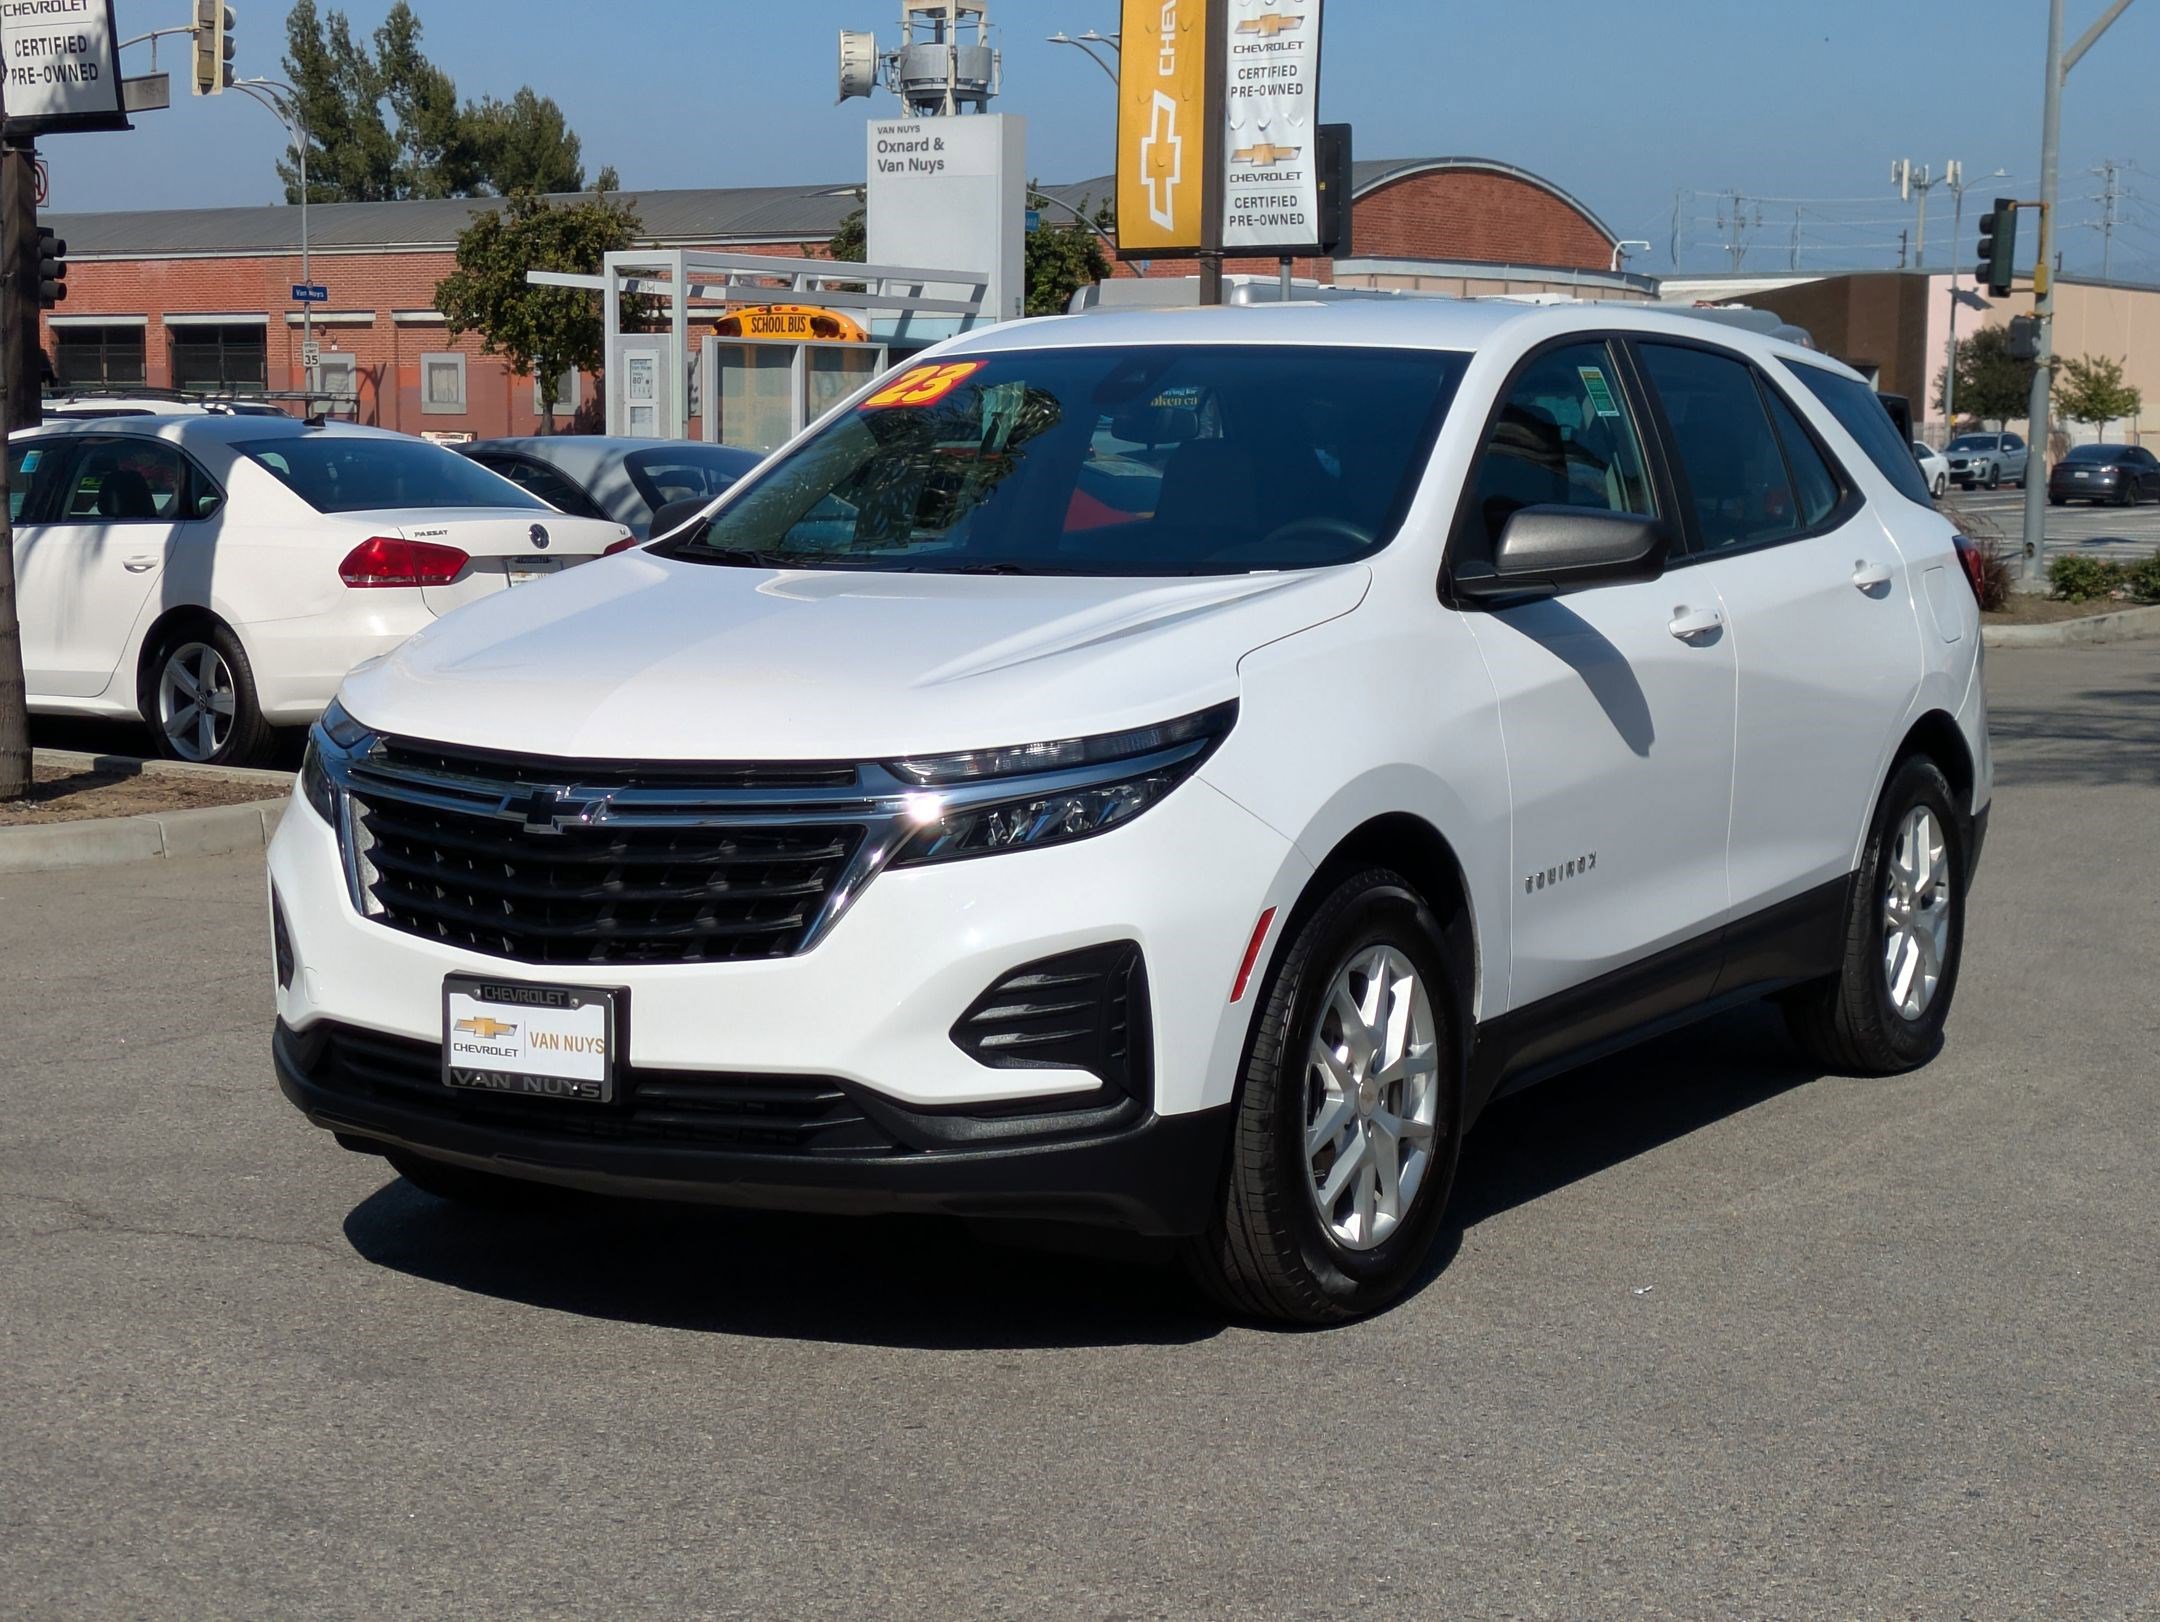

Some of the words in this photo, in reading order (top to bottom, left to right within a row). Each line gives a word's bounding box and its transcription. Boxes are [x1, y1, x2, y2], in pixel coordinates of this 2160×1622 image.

[14, 34, 88, 58] CERTIFIED
[1233, 41, 1304, 54] CHEVROLET
[11, 62, 99, 87] PRE-OWNED
[1237, 64, 1298, 80] CERTIFIED
[1230, 83, 1304, 98] PRE-OWNED
[877, 126, 895, 135] VAN
[896, 124, 921, 133] NUYS
[876, 137, 930, 154] Oxnard
[933, 137, 945, 151] &
[877, 159, 905, 173] Van
[908, 157, 945, 175] Nuys
[1229, 172, 1304, 183] CHEVROLET
[1234, 195, 1298, 209] CERTIFIED
[1229, 212, 1305, 227] PRE-OWNED
[751, 316, 786, 334] SCHOOL
[788, 315, 806, 333] BUS
[304, 354, 319, 366] 35
[864, 362, 978, 407] 23
[414, 529, 449, 538] PASSAT
[1525, 850, 1597, 895] EQUINOX
[483, 985, 567, 1006] CHEVROLET
[453, 1042, 520, 1058] CHEVROLET
[529, 1031, 560, 1050] VAN
[564, 1035, 605, 1055] NUYS
[453, 1069, 512, 1089] VAN
[523, 1077, 601, 1099] NUYS
